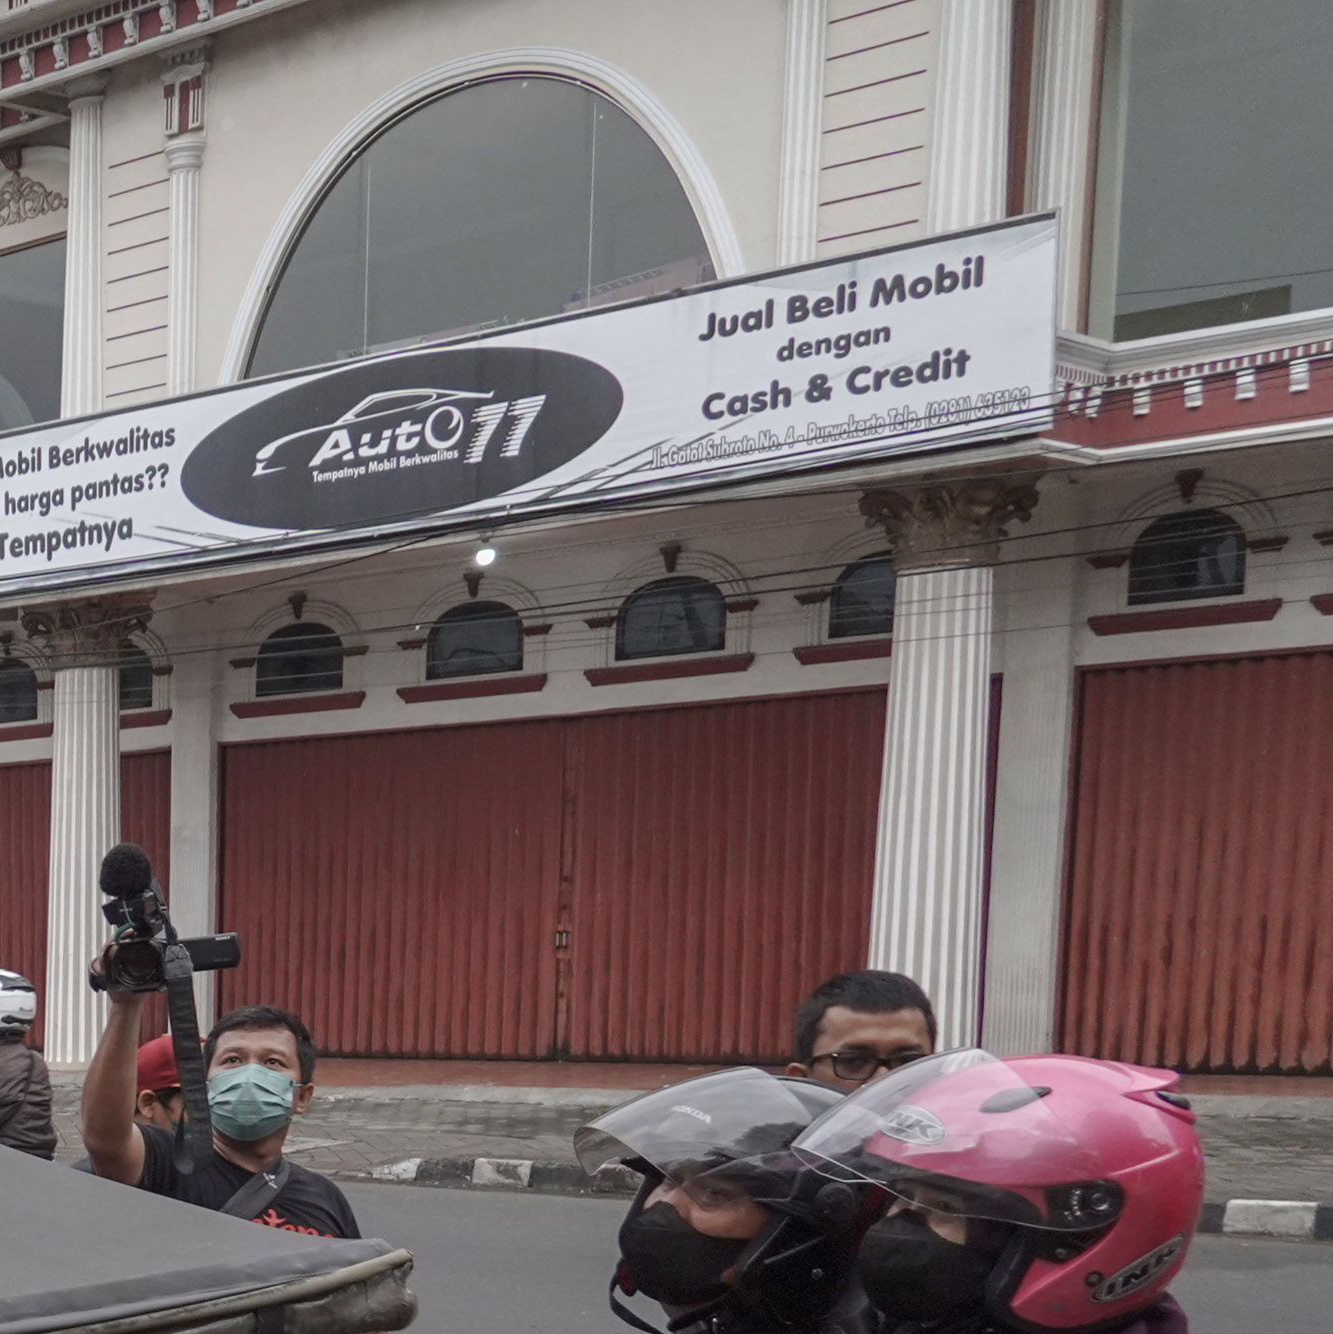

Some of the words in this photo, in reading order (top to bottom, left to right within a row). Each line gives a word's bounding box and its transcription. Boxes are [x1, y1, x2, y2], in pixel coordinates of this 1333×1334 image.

[699, 299, 774, 342] Jual
[787, 281, 858, 323] Beli
[870, 256, 985, 309] Mobil
[777, 325, 891, 362] dengan
[702, 381, 792, 421] Cash
[805, 374, 833, 403] &
[846, 348, 970, 395] Credit
[48, 426, 176, 469] Berkwalitas
[785, 426, 795, 448] 4
[806, 414, 885, 446] Purwokerto
[312, 465, 366, 483] Tempatnya
[368, 456, 397, 474] Mobil
[400, 448, 459, 469] Berkwalitas
[4, 484, 65, 518] harga
[71, 463, 169, 511] pantas??
